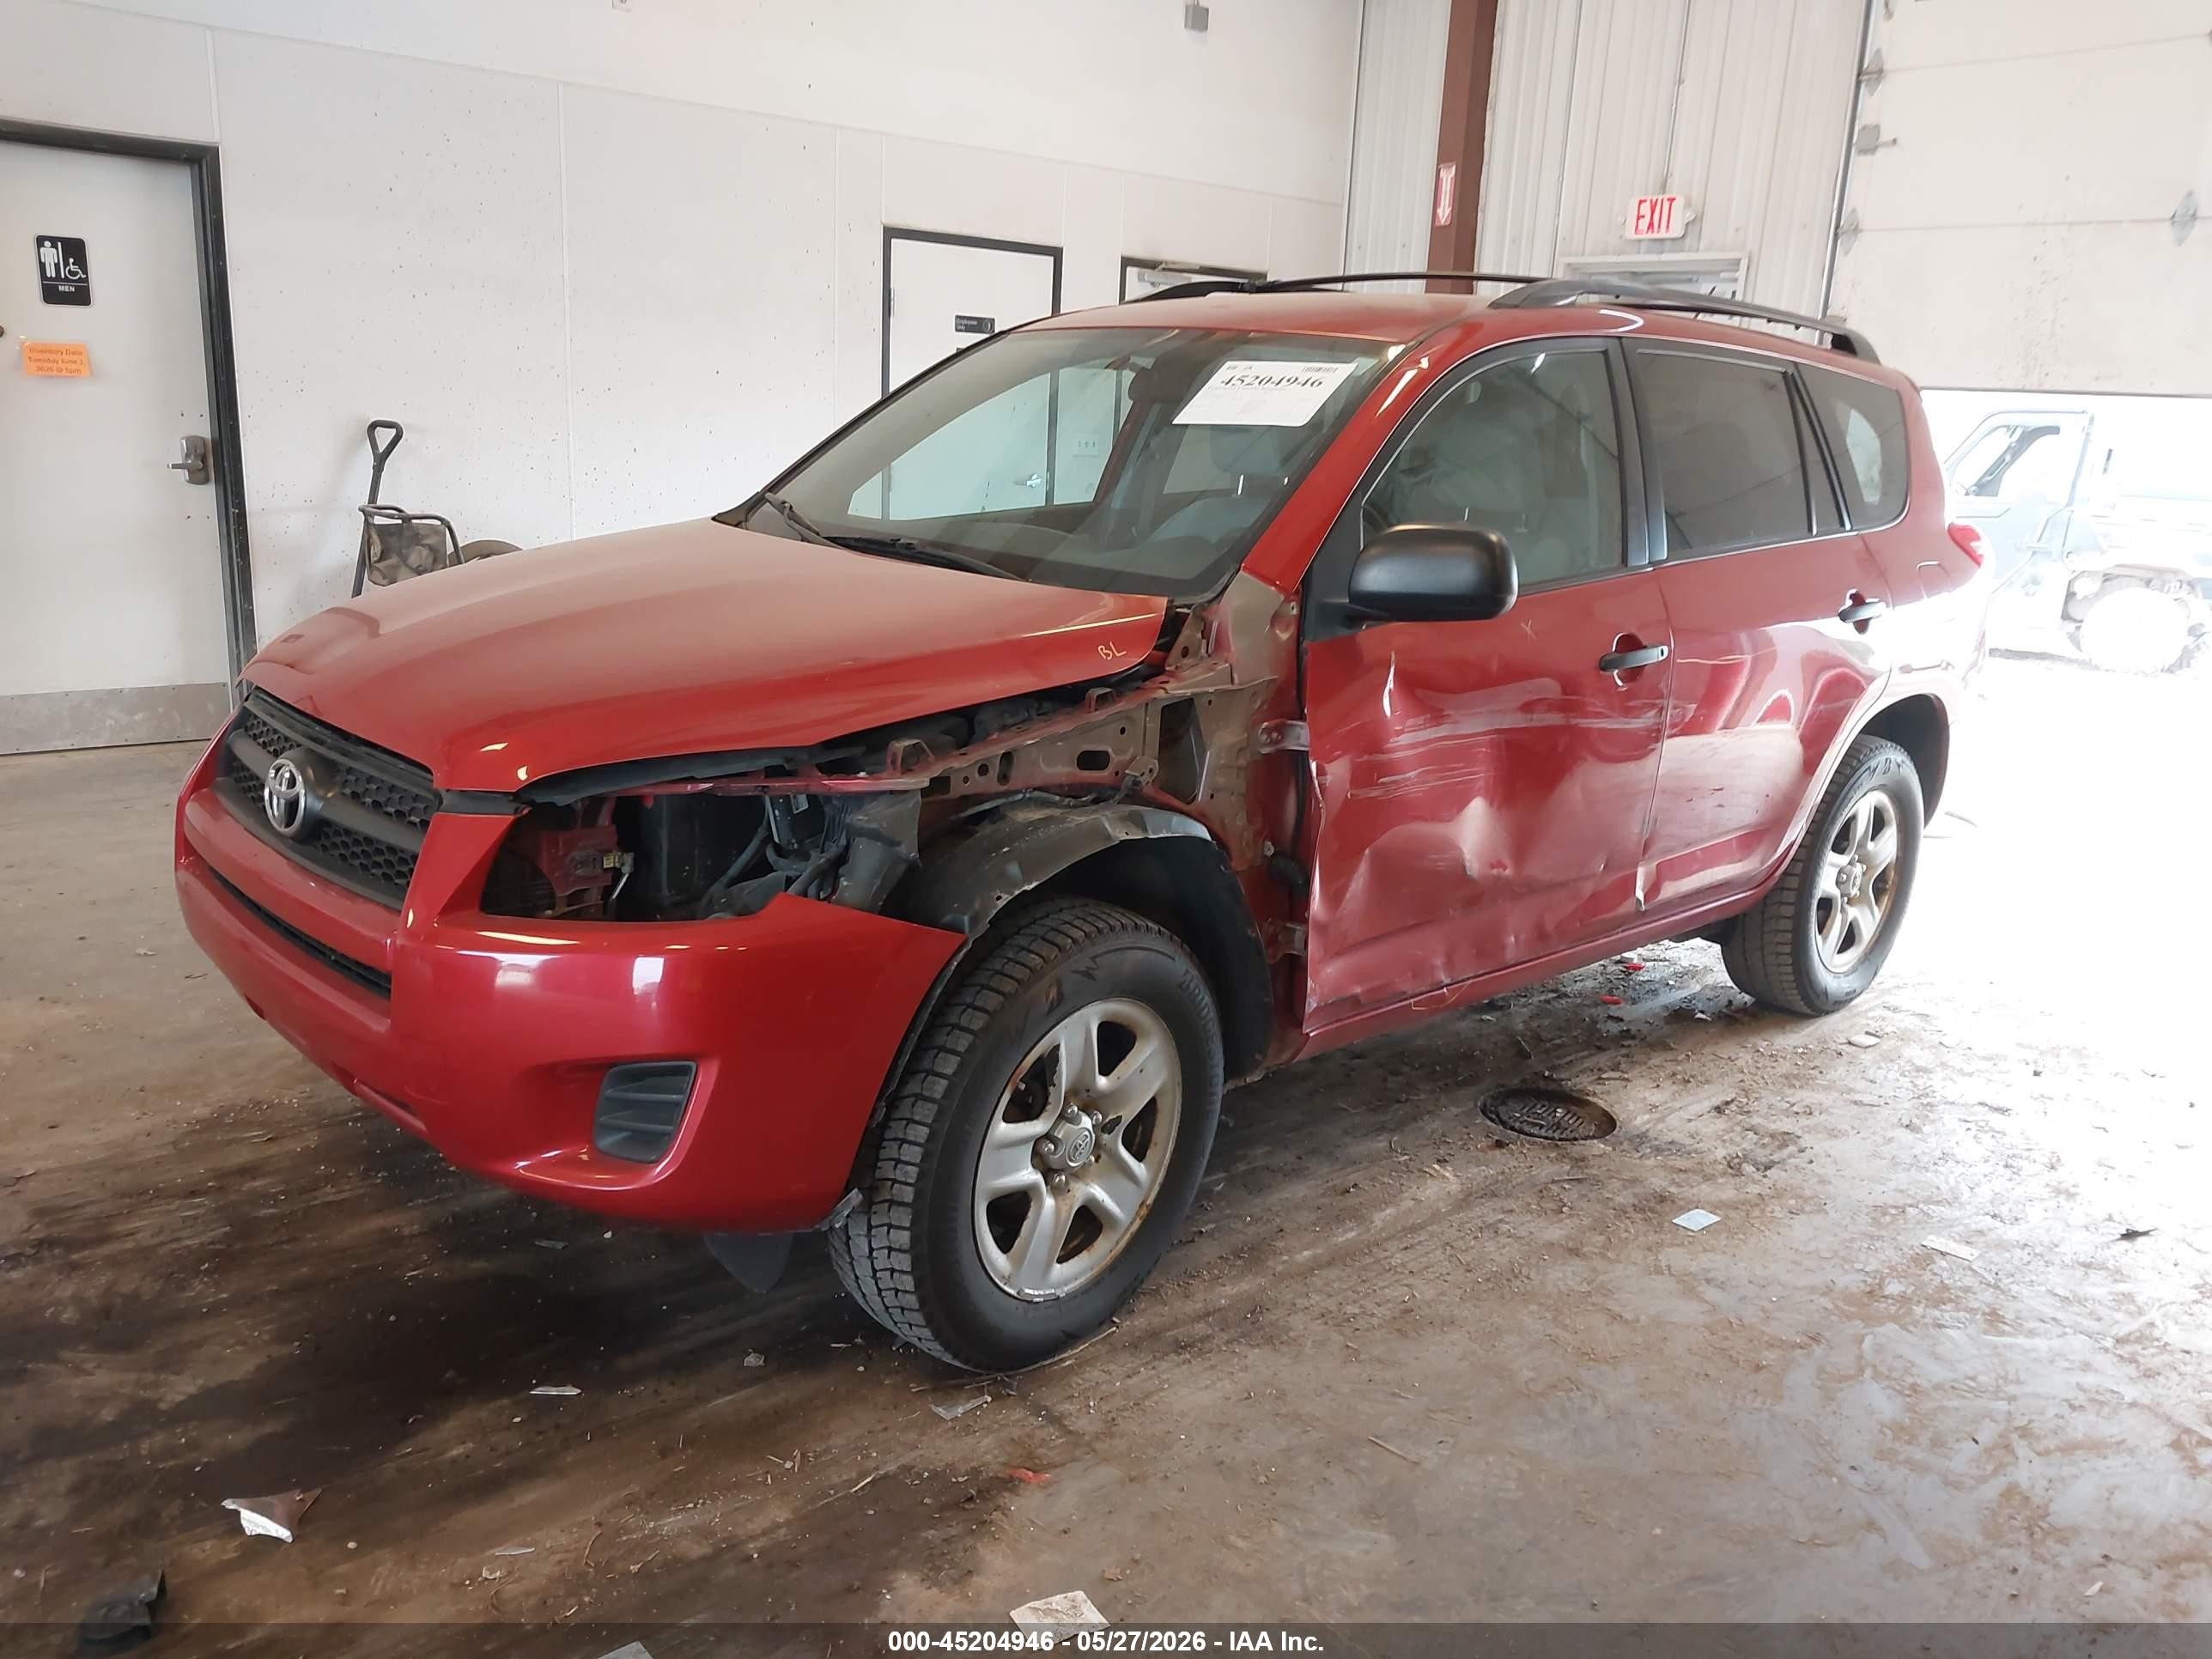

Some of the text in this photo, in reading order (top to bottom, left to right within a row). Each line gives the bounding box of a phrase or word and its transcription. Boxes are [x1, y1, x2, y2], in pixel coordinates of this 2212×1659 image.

[1634, 197, 1676, 234] EXIT
[58, 284, 76, 293] MEN
[27, 356, 59, 365] Tuesday
[1220, 374, 1324, 388] 45204946
[1097, 641, 1127, 660] BL
